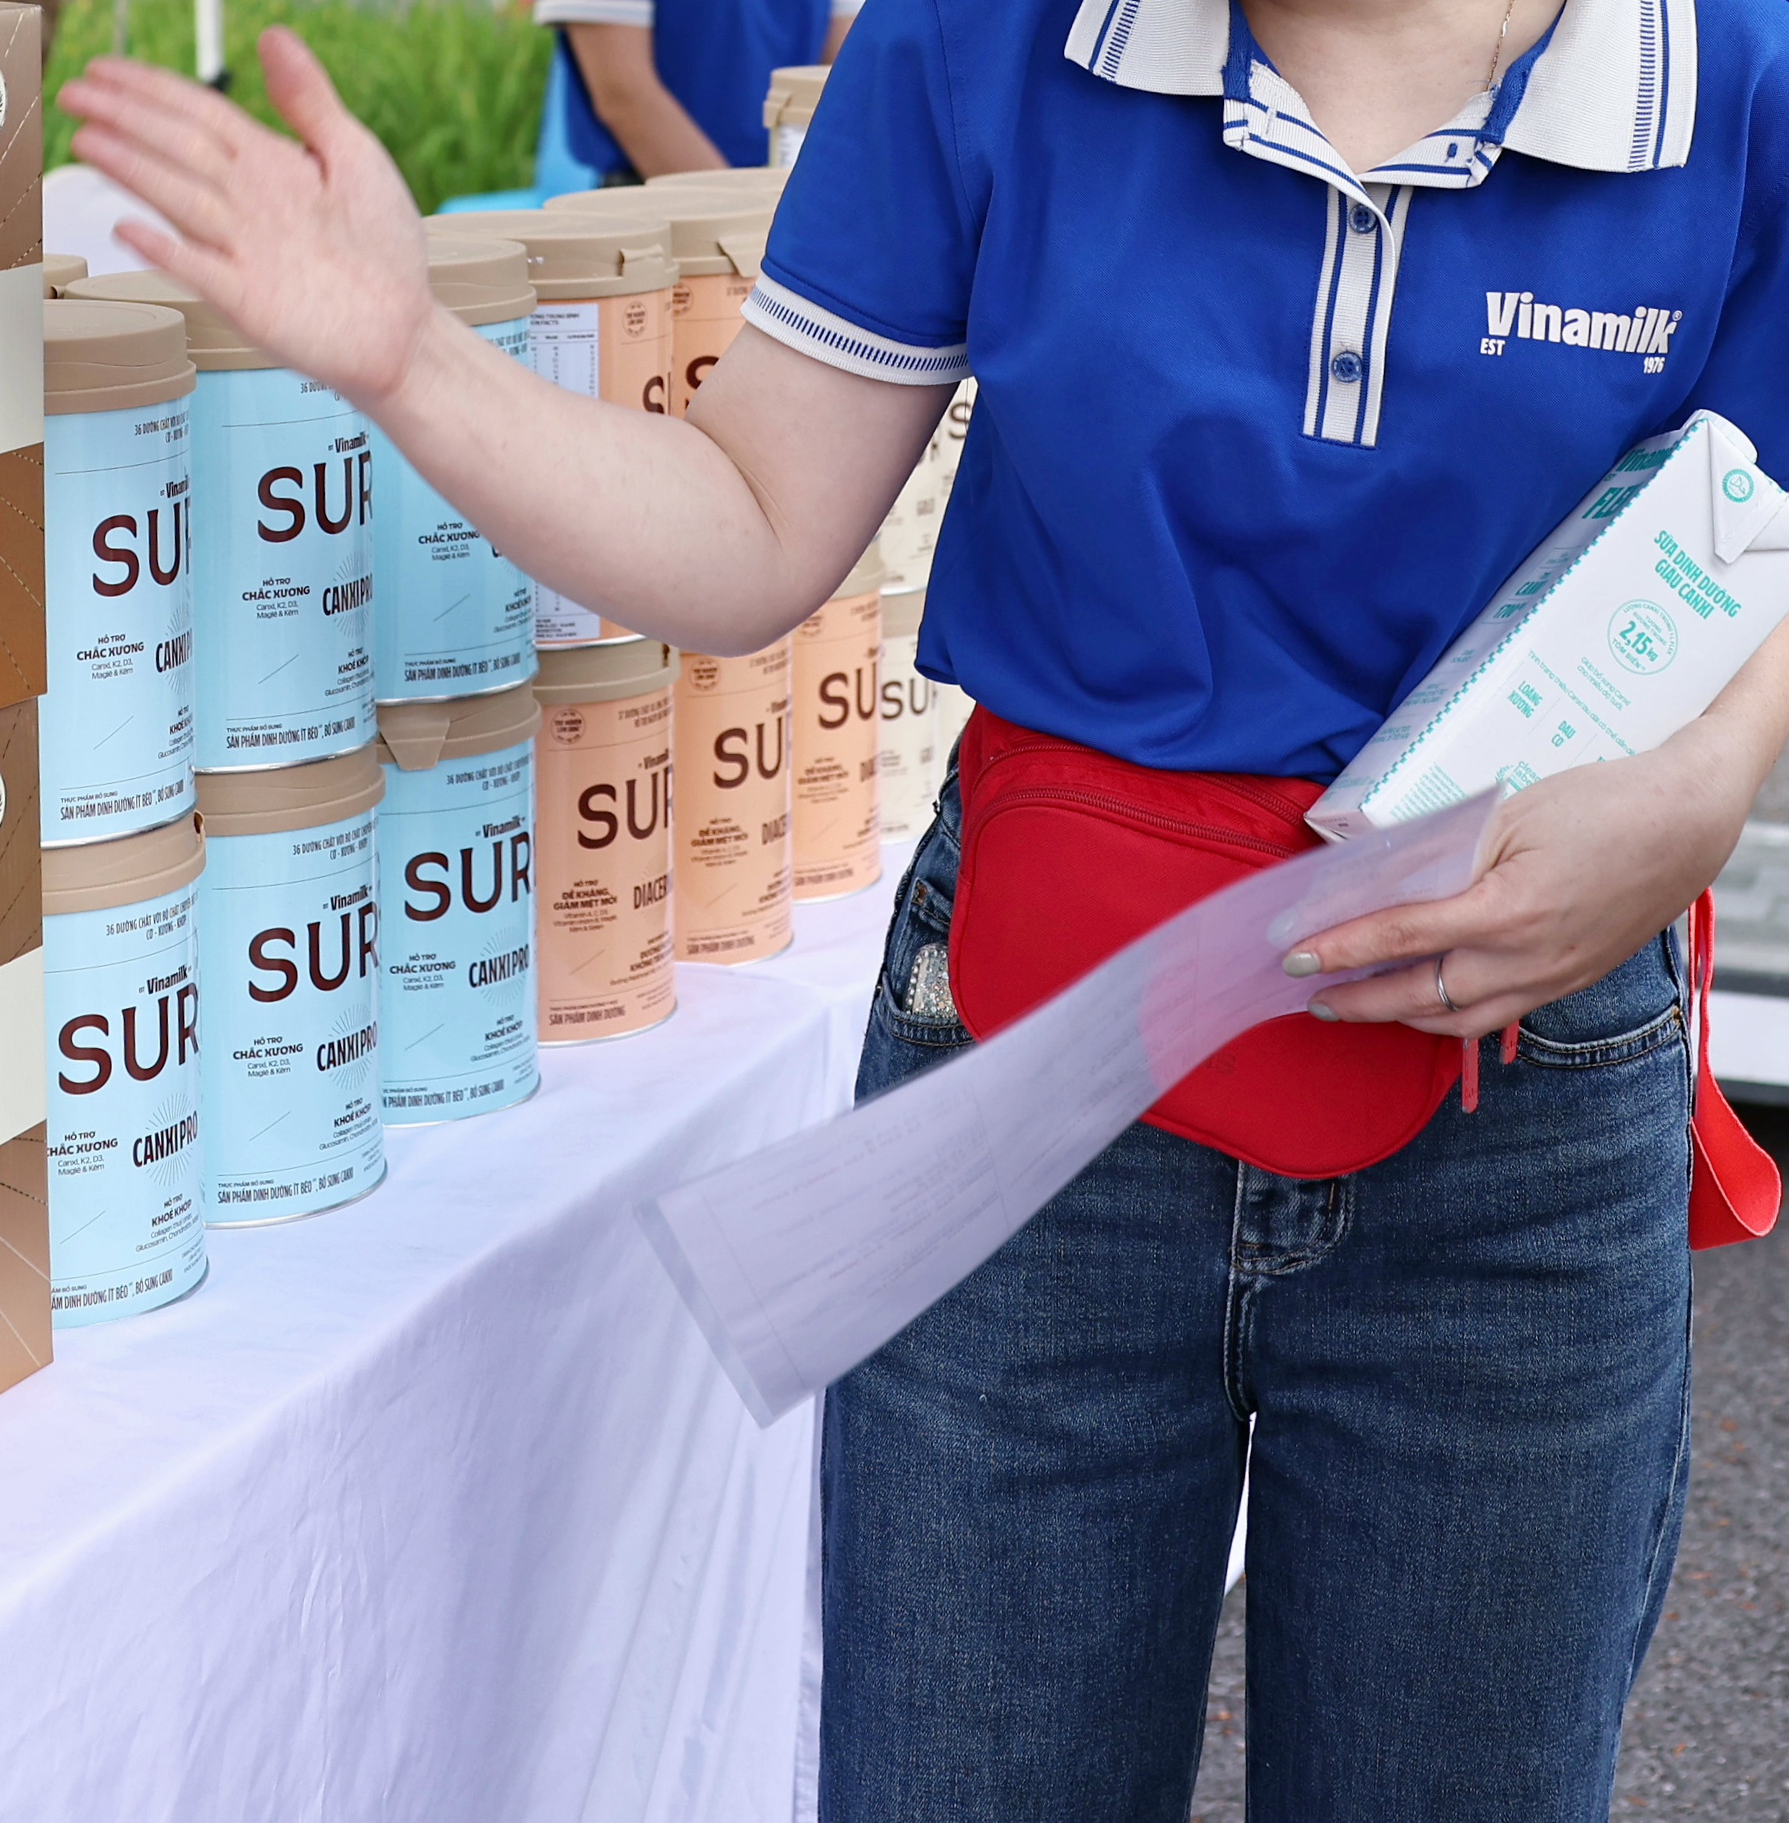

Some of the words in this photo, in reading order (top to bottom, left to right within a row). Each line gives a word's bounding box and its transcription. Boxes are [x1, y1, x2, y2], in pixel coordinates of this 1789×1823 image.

[1485, 291, 1678, 353] Vinamilk
[1480, 338, 1505, 355] EST
[1643, 357, 1665, 373] 1976
[92, 497, 191, 597] SU
[418, 532, 445, 544] CHẮC
[263, 577, 274, 586] HỖ
[1653, 530, 1678, 558] SỮA
[1672, 549, 1703, 582] DINH
[1697, 577, 1742, 618] DƯỠNG
[242, 588, 271, 601] CHẮC
[273, 586, 310, 598] XƯƠNG
[1654, 559, 1683, 589] GIÀU
[1678, 583, 1715, 619] CANXI
[98, 635, 109, 645] HỖ
[111, 634, 126, 642] TRỢ
[1619, 620, 1653, 655] 2,15
[1646, 647, 1658, 662] kg
[77, 647, 106, 661] CHẮC
[108, 642, 144, 657] XƯƠNG
[293, 844, 301, 856] 36
[302, 840, 321, 854] DƯỠNG
[330, 884, 369, 910] Vinamilk
[106, 924, 115, 936] 36
[116, 919, 137, 934] DƯỠNG
[139, 913, 152, 930] CHẤT
[248, 901, 380, 1003] SUR
[390, 961, 418, 975] CHẮC
[419, 961, 456, 973] XƯƠNG
[147, 965, 188, 994] Vinamilk
[59, 982, 200, 1095] SUR
[254, 1037, 265, 1046] HỖ
[267, 1036, 283, 1044] TRỢ
[233, 1046, 262, 1060] CHẮC
[264, 1043, 303, 1057] XƯƠNG
[65, 1131, 77, 1141] HỖ
[79, 1131, 96, 1139] TRỢ
[76, 1138, 118, 1154] XƯƠNG
[218, 1187, 230, 1204] SẢN
[232, 1185, 251, 1203] PHẨM
[253, 1185, 269, 1201] DINH
[270, 1180, 292, 1198] DƯỠNG
[152, 1209, 174, 1227] KHOẺ
[65, 1293, 82, 1309] DINH
[83, 1287, 107, 1306] DƯỠNG
